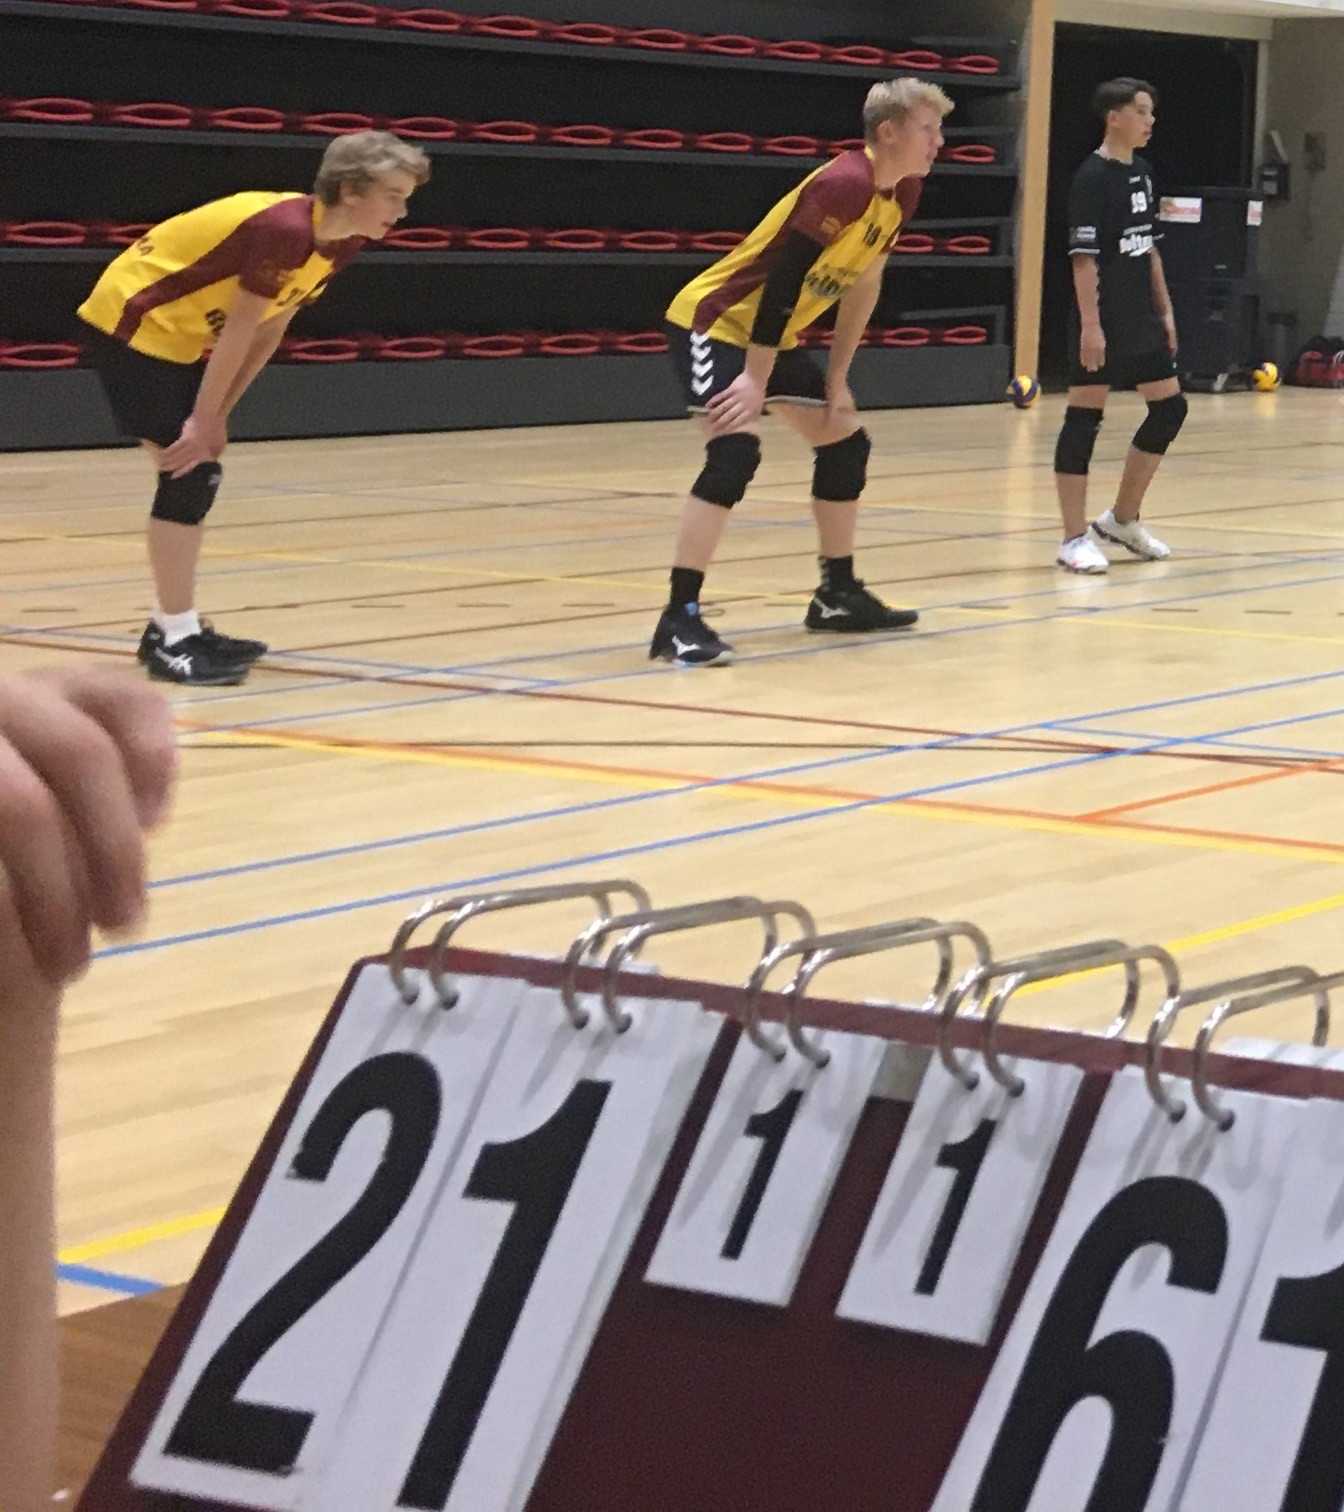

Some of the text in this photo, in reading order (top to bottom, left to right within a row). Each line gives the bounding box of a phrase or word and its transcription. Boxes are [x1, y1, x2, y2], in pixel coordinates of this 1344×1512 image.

[162, 1051, 613, 1510] 21
[720, 1089, 803, 1261] 1
[914, 1118, 997, 1296] 1
